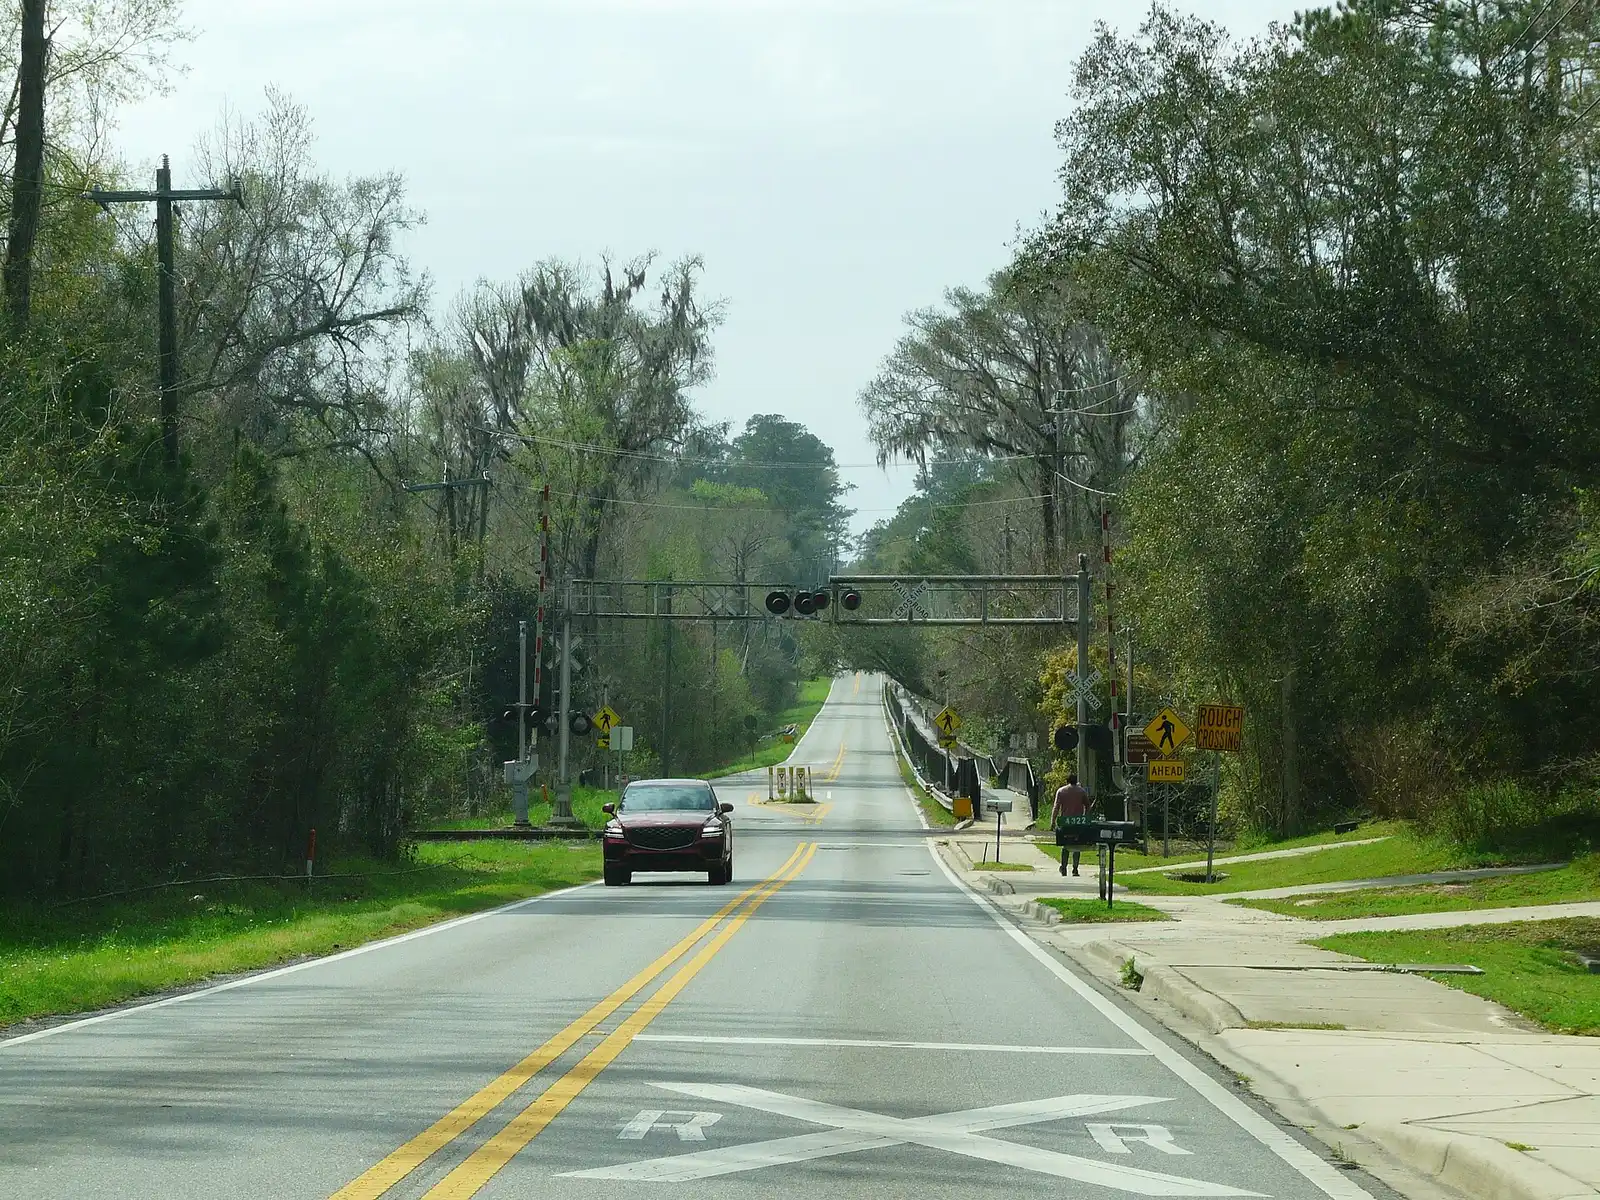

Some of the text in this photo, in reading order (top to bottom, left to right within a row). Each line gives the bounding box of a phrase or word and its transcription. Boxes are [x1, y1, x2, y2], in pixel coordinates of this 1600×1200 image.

[895, 584, 927, 616] CROSSING
[1066, 673, 1098, 704] CROSSING
[1199, 707, 1240, 728] ROUGH
[1197, 728, 1239, 749] CROSSING
[1151, 765, 1183, 776] AHEAD
[1065, 816, 1087, 825] 4322
[616, 1109, 723, 1140] R
[1084, 1122, 1195, 1154] R
